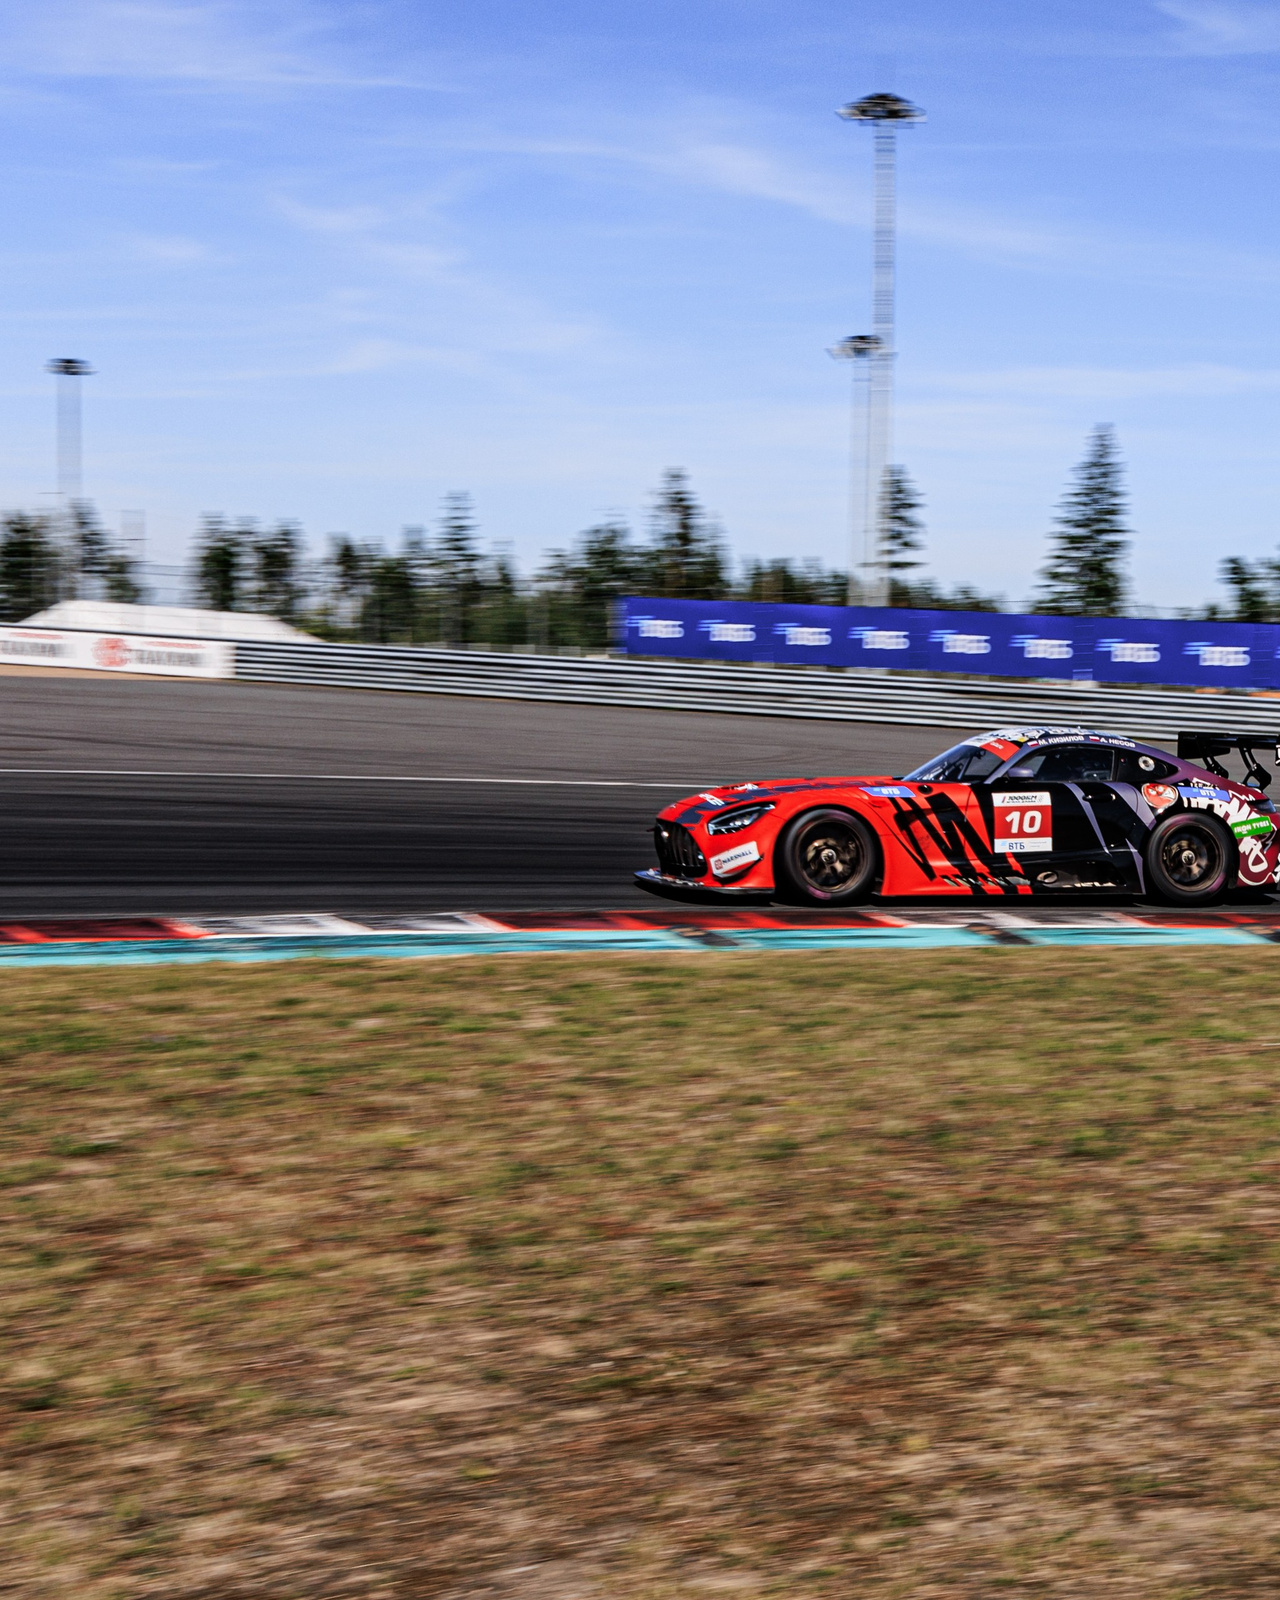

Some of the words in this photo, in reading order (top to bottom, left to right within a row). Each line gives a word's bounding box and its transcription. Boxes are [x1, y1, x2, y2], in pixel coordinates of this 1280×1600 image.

[1048, 735, 1085, 745] КИЗИЛОВ
[1108, 738, 1136, 748] НЕСОВ
[1005, 810, 1042, 834] 10
[1008, 841, 1025, 851] ВТБ
